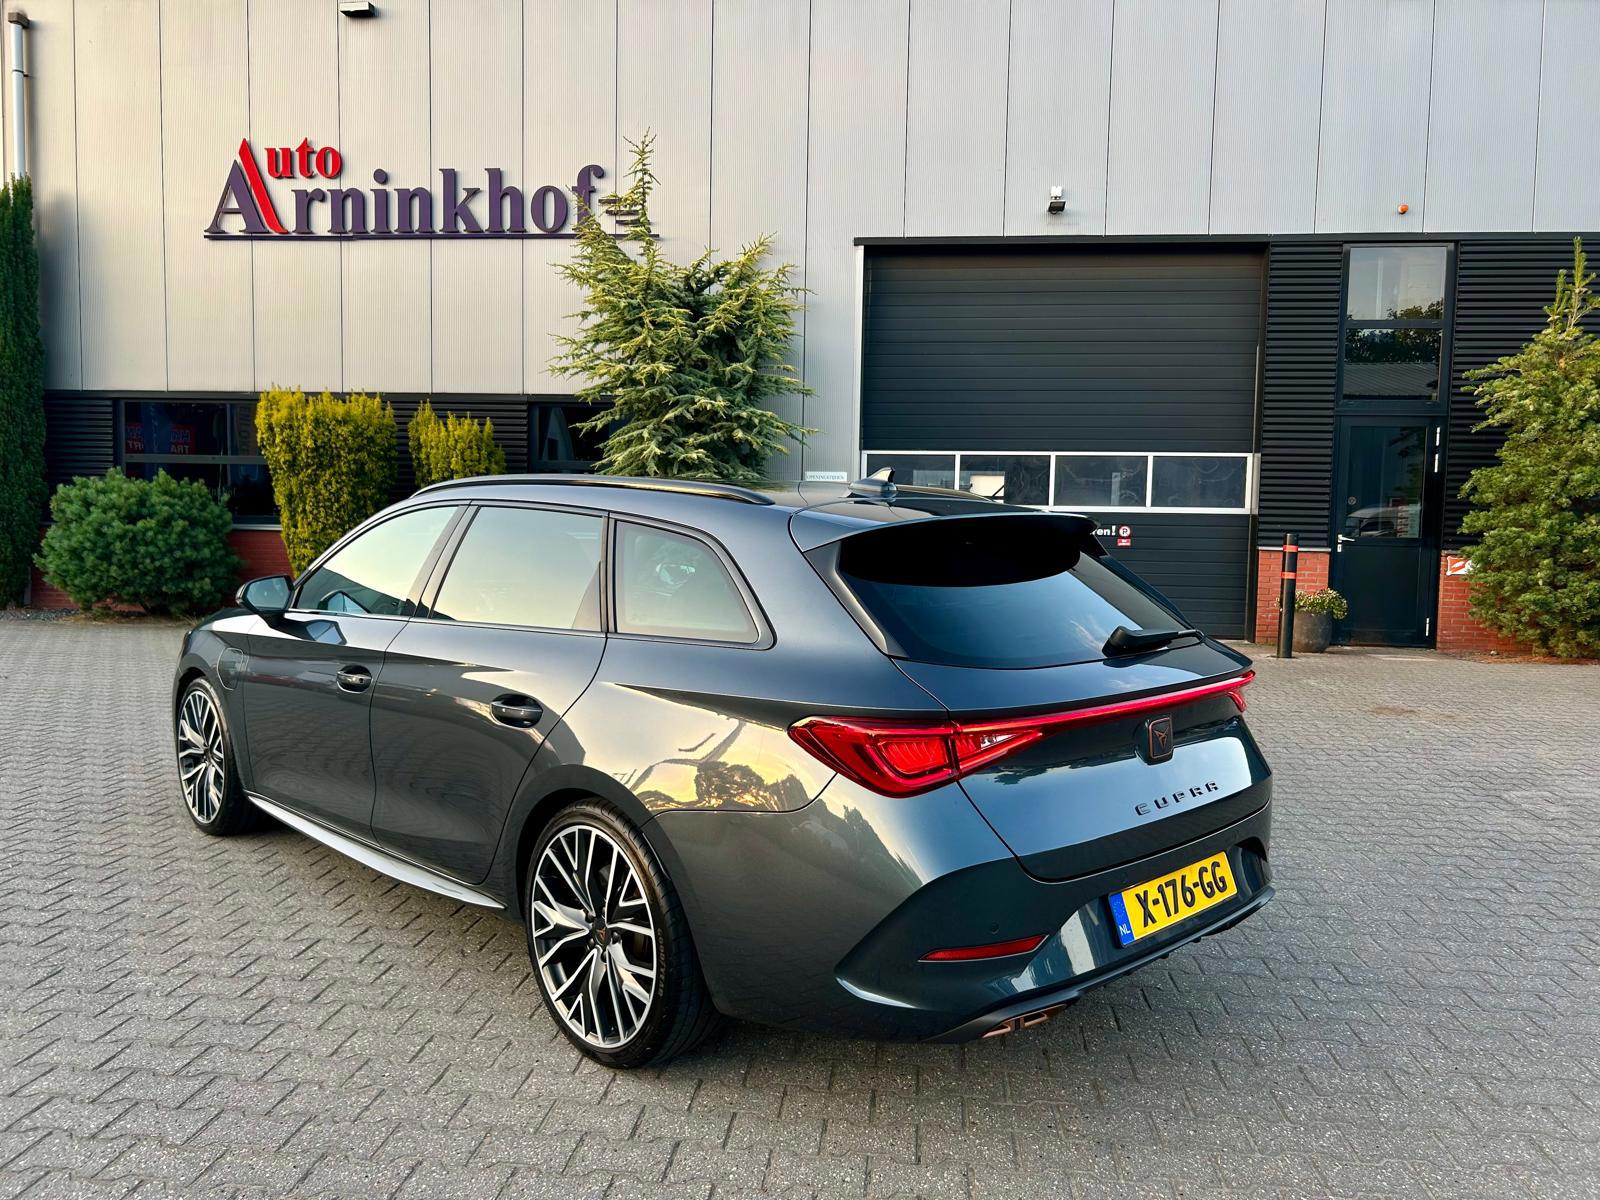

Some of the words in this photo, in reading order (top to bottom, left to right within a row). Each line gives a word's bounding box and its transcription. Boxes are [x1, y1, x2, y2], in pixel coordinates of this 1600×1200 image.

[203, 158, 605, 233] Arninkhof
[1135, 781, 1219, 816] CUPRA
[1135, 861, 1228, 928] X-176-GG
[657, 928, 666, 998] GOODYEAR
[1119, 924, 1131, 935] NL
